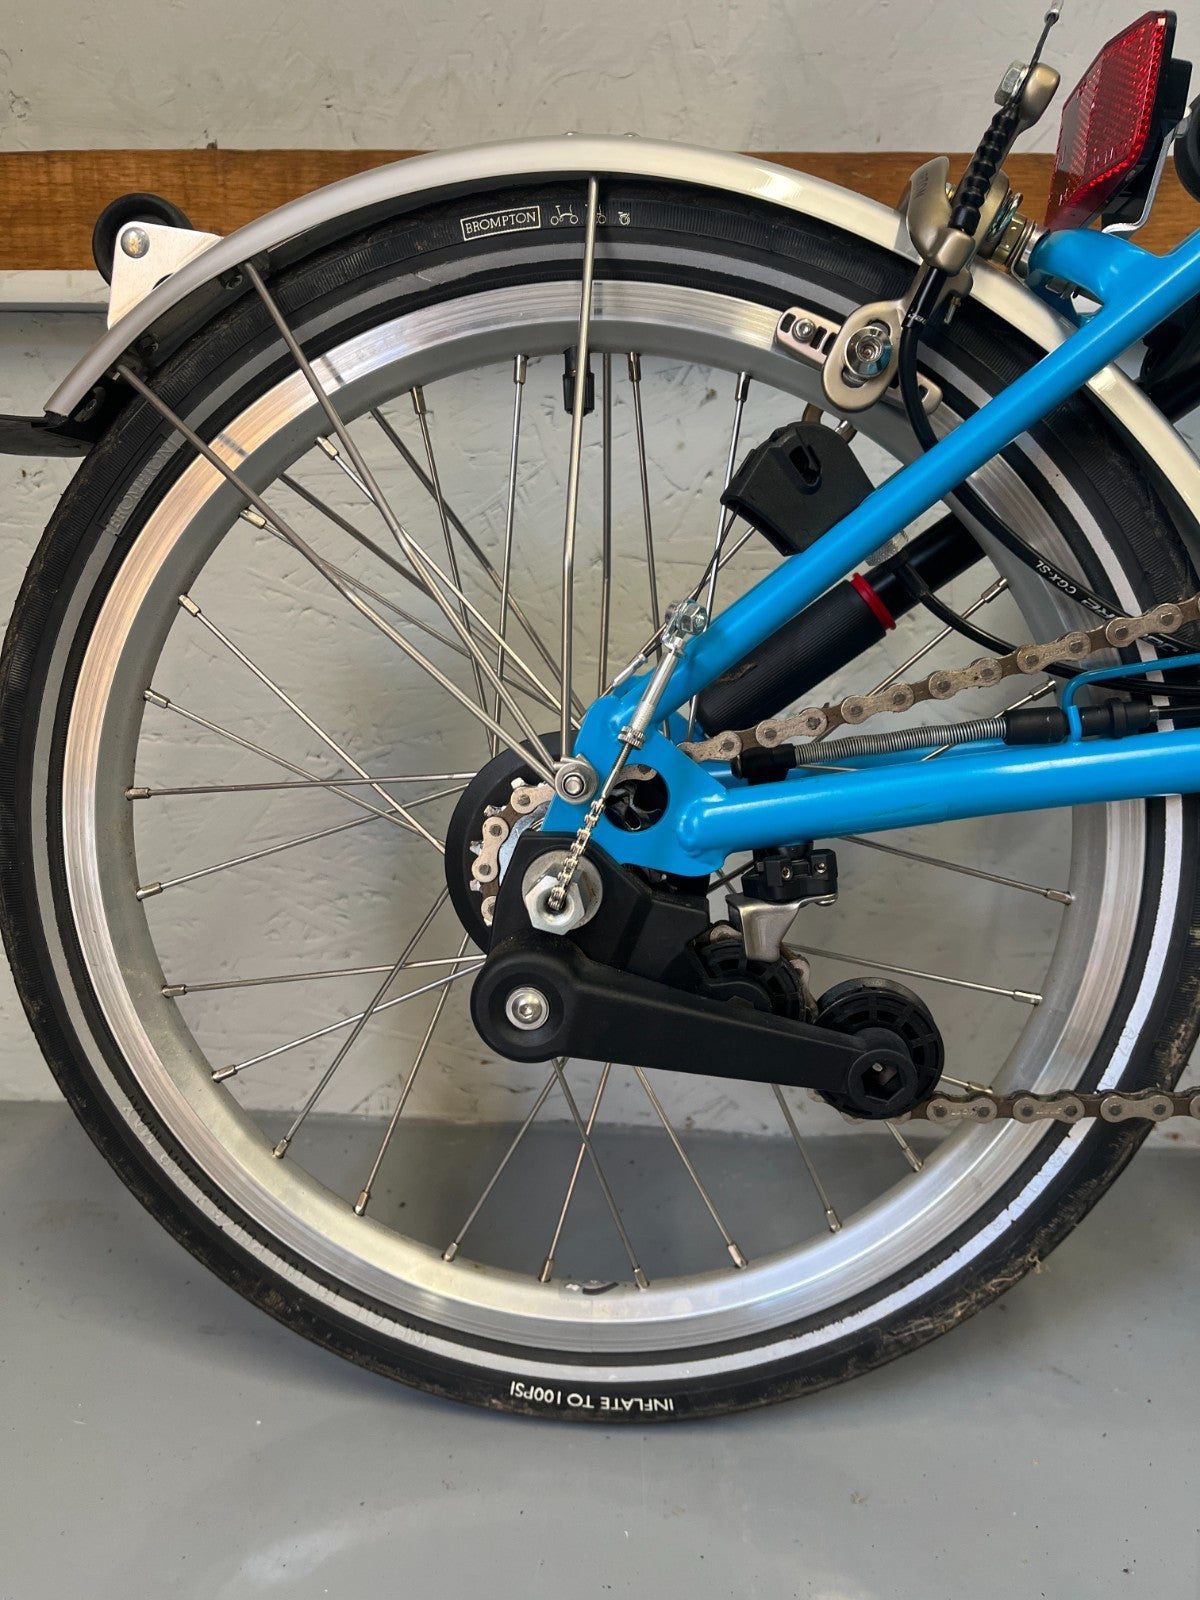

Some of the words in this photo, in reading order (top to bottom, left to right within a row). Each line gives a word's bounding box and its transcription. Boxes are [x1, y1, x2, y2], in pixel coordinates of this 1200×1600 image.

[464, 211, 537, 235] BROMPTON
[1036, 560, 1077, 594] CGX-SL
[510, 1381, 562, 1405] 100PSI
[566, 1393, 595, 1409] TO
[600, 1396, 674, 1412] INFLATE
